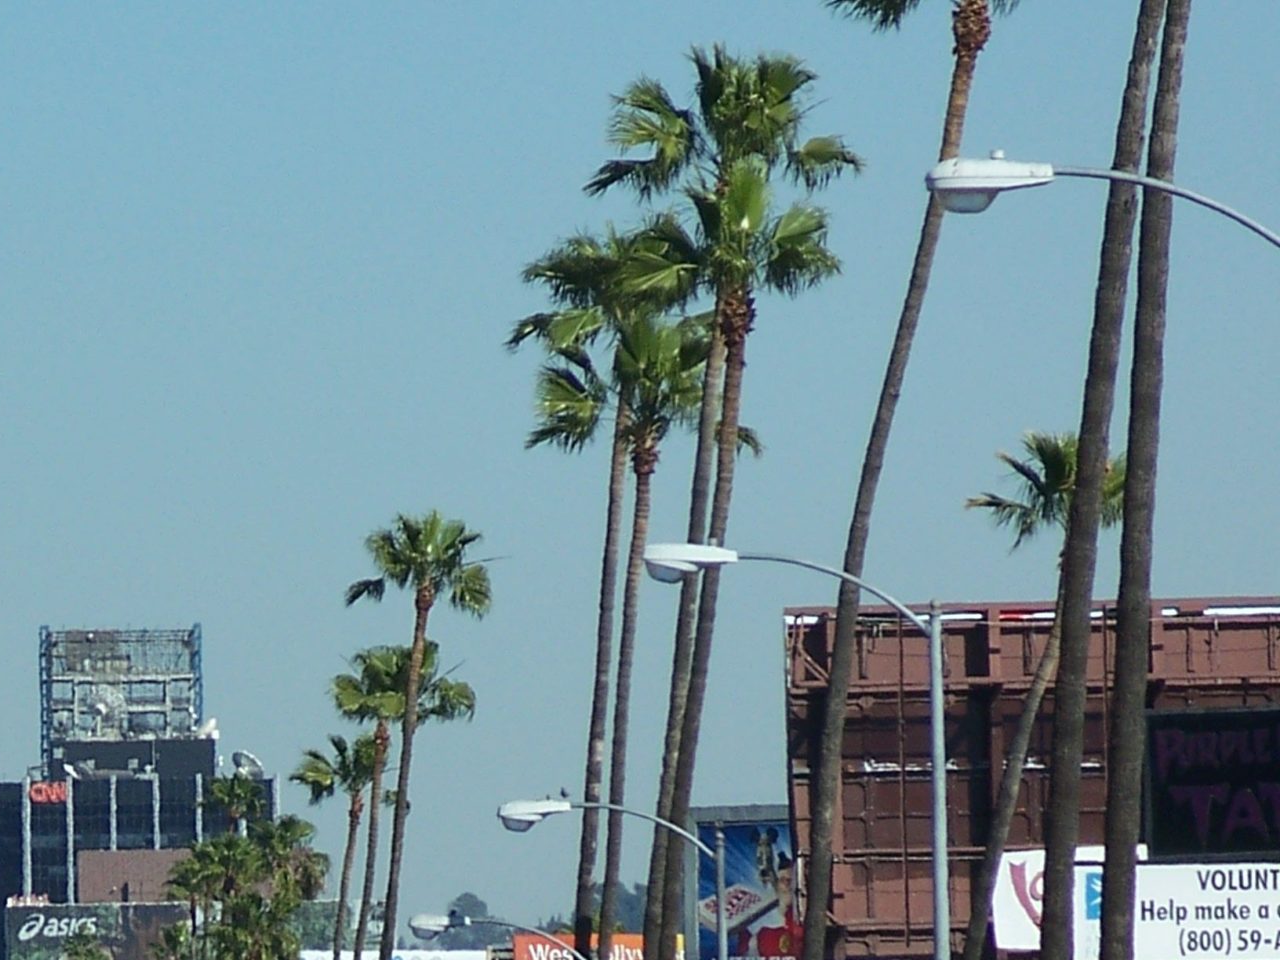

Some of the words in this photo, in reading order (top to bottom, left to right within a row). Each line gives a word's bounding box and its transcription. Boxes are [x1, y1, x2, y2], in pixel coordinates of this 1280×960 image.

[30, 782, 66, 803] CNN
[1140, 899, 1188, 925] Help
[1195, 898, 1251, 920] make
[1258, 903, 1269, 919] a
[1179, 928, 1232, 957] (800)
